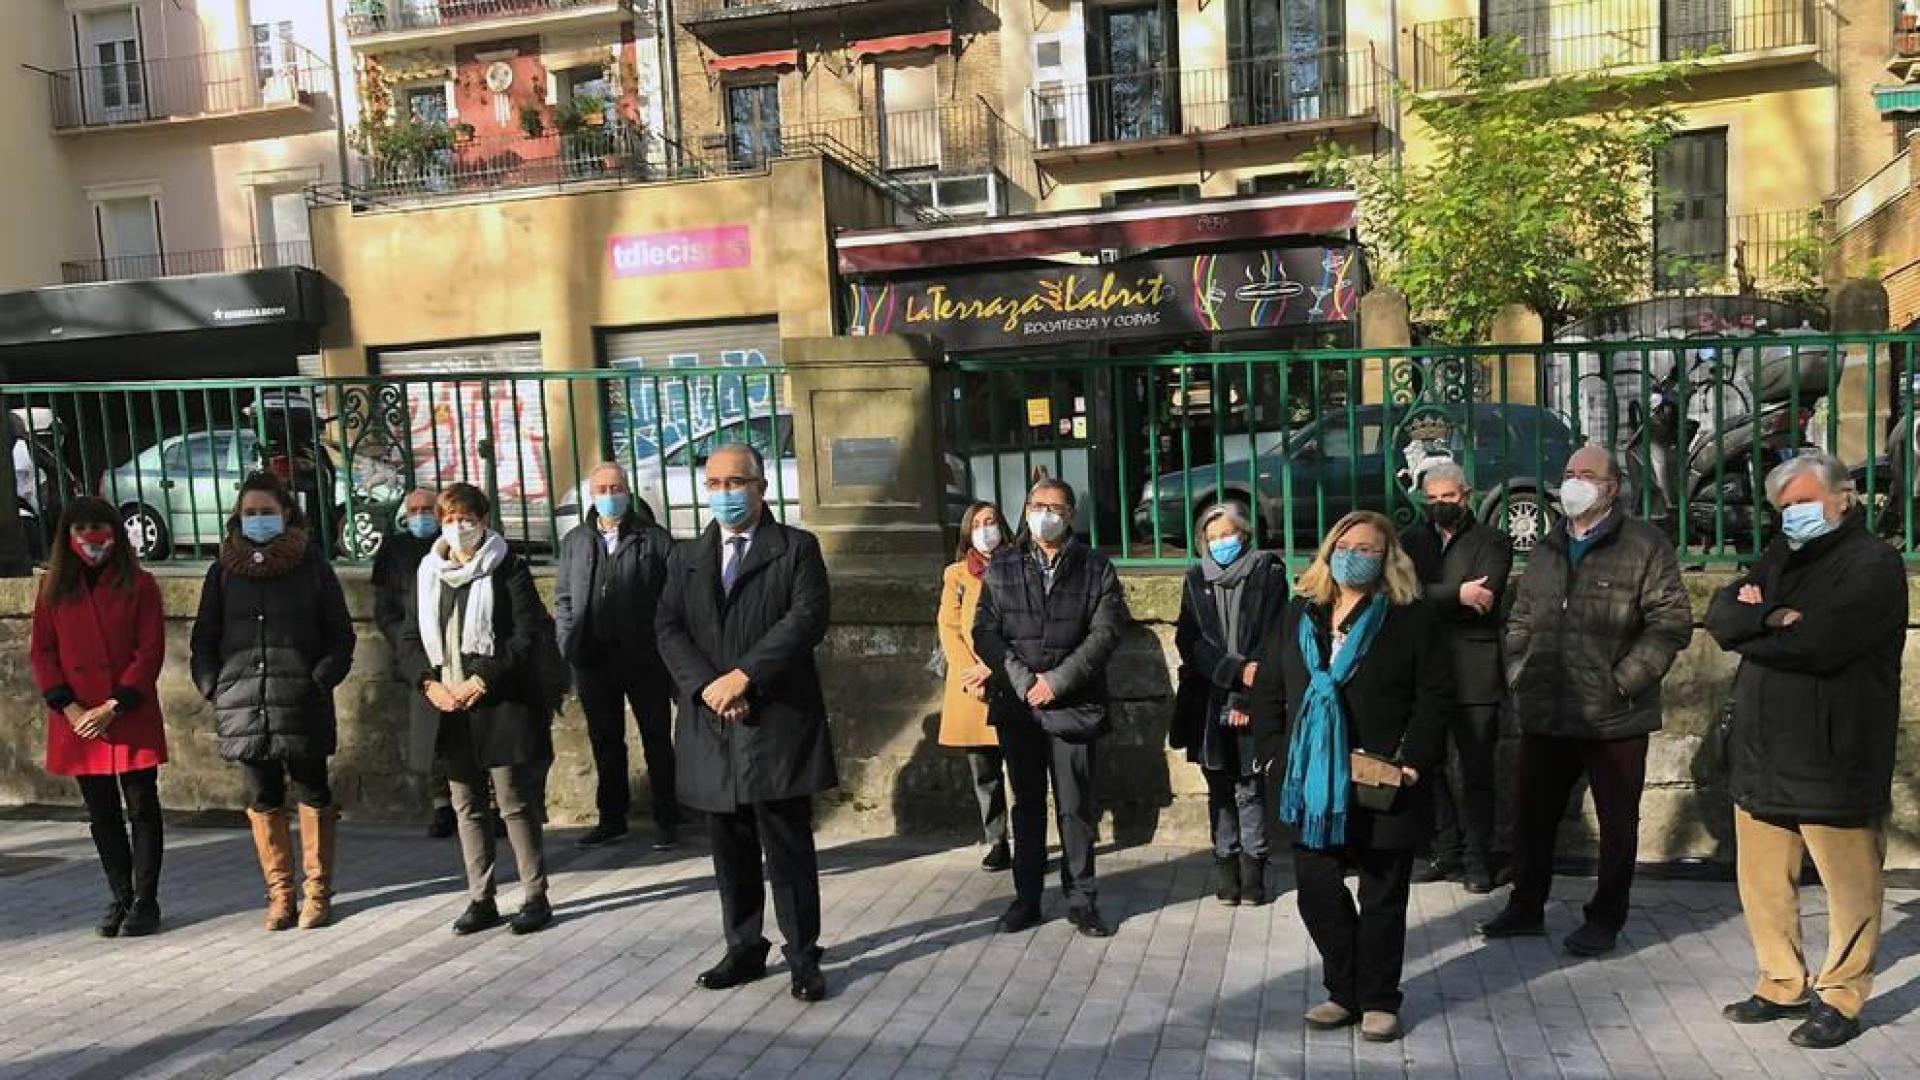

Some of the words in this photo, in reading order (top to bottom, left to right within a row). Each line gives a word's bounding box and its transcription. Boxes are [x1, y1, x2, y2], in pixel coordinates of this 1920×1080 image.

[927, 284, 1044, 333] Terraza
[1065, 271, 1163, 311] Labrit
[1102, 315, 1110, 328] Y
[1114, 311, 1161, 328] COPAS
